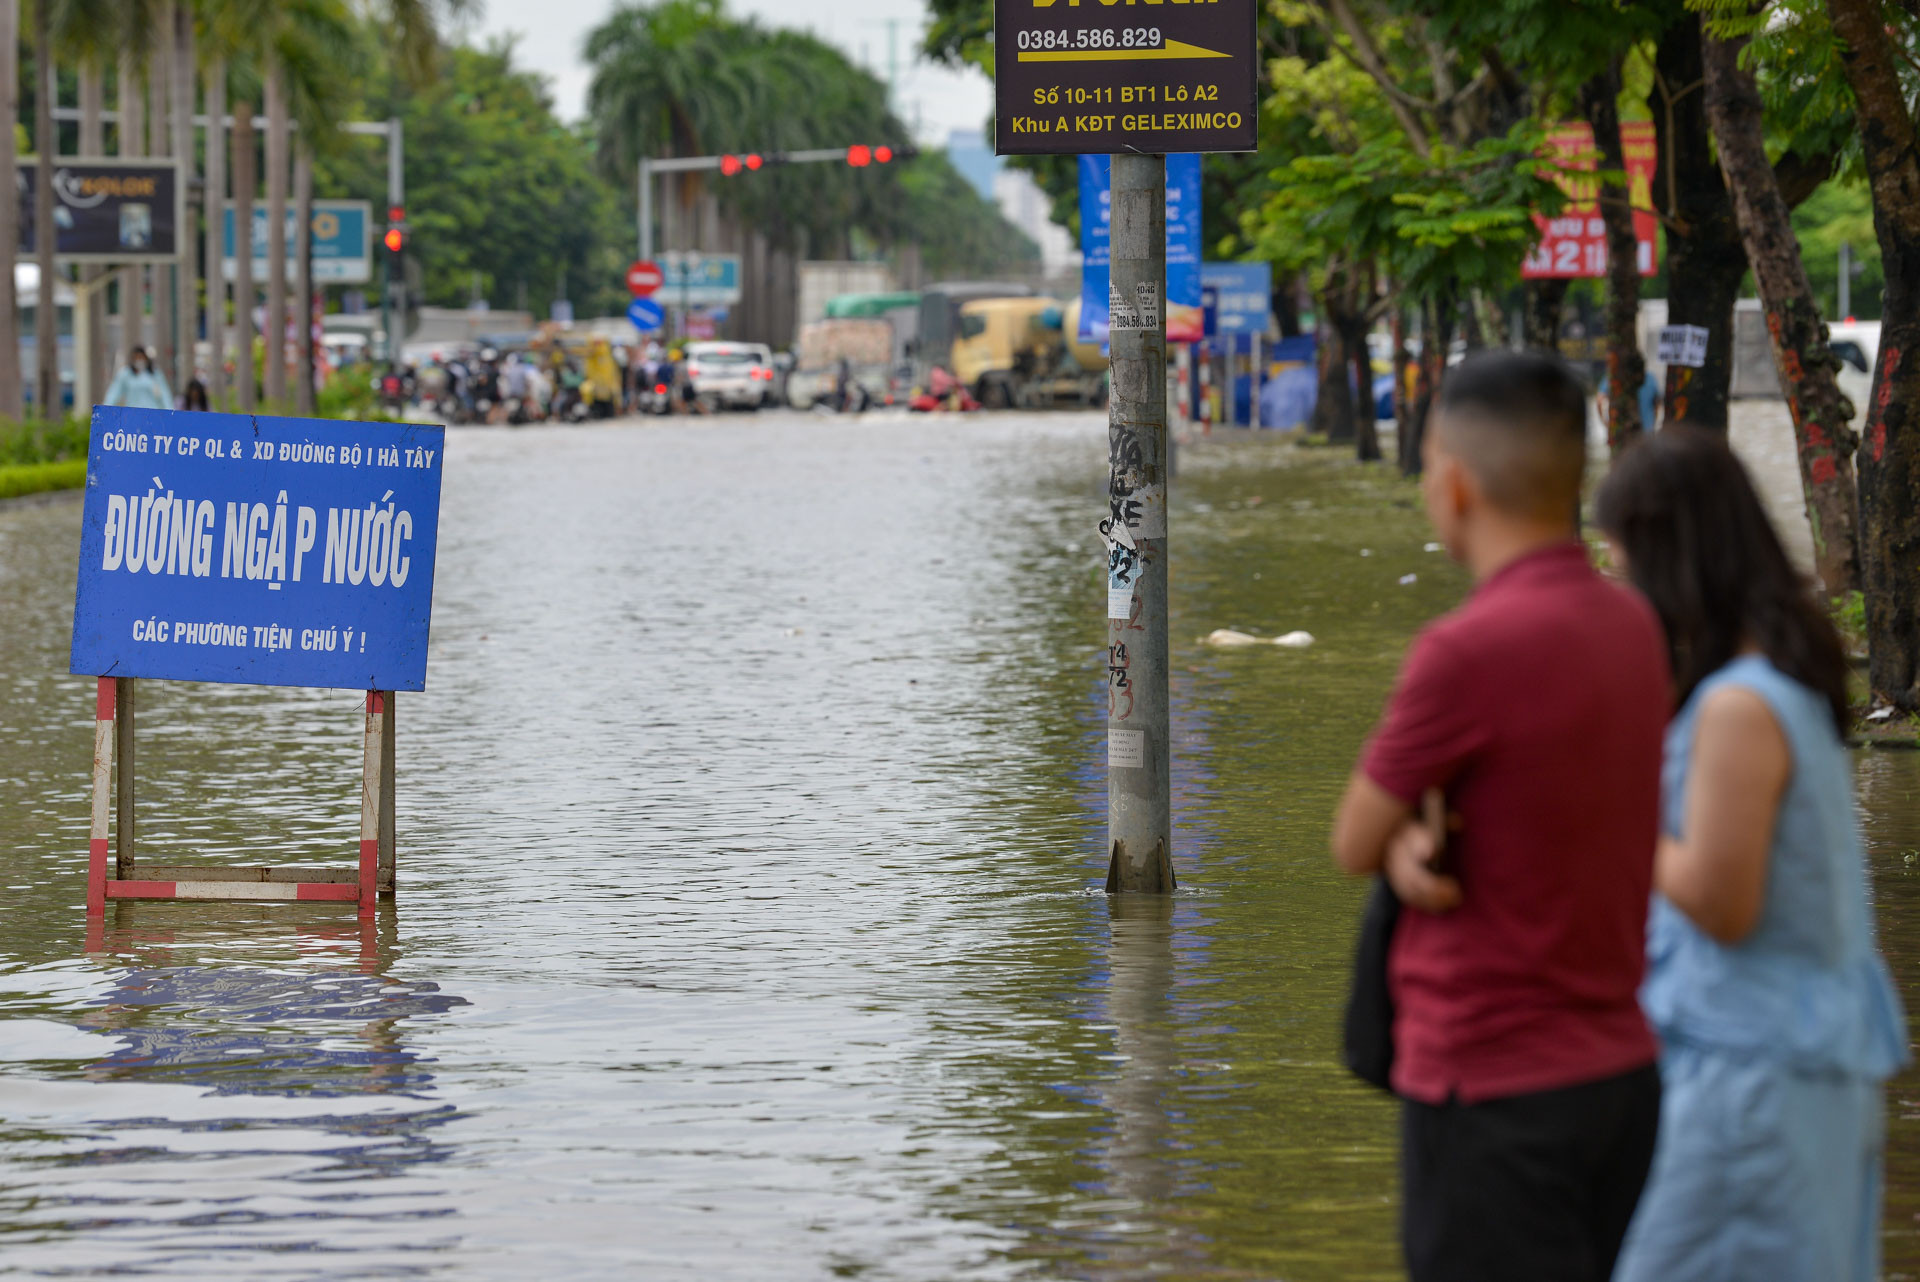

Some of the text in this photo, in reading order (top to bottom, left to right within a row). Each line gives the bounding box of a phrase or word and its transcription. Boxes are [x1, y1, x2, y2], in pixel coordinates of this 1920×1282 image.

[1017, 27, 1161, 49] 0384.586.829
[1033, 84, 1219, 105] Số 10-11 BT1 Lô A2
[1012, 111, 1242, 133] Khu A KĐT GELEXIMCO
[102, 428, 148, 453] CÔNG
[153, 435, 173, 454] TY
[177, 436, 200, 456] CP
[204, 438, 225, 459] QL
[230, 439, 242, 459] &
[252, 441, 274, 461] XD
[340, 443, 362, 469] BỘ
[377, 444, 400, 467] HÀ
[404, 445, 435, 469] TÂY
[102, 475, 216, 578] ĐƯỜNG
[322, 489, 413, 588] NƯỚC
[132, 615, 169, 643] CÁC
[173, 621, 248, 647] PHƯƠNG
[252, 622, 293, 653] TIỆN
[300, 625, 338, 652] CHÚ
